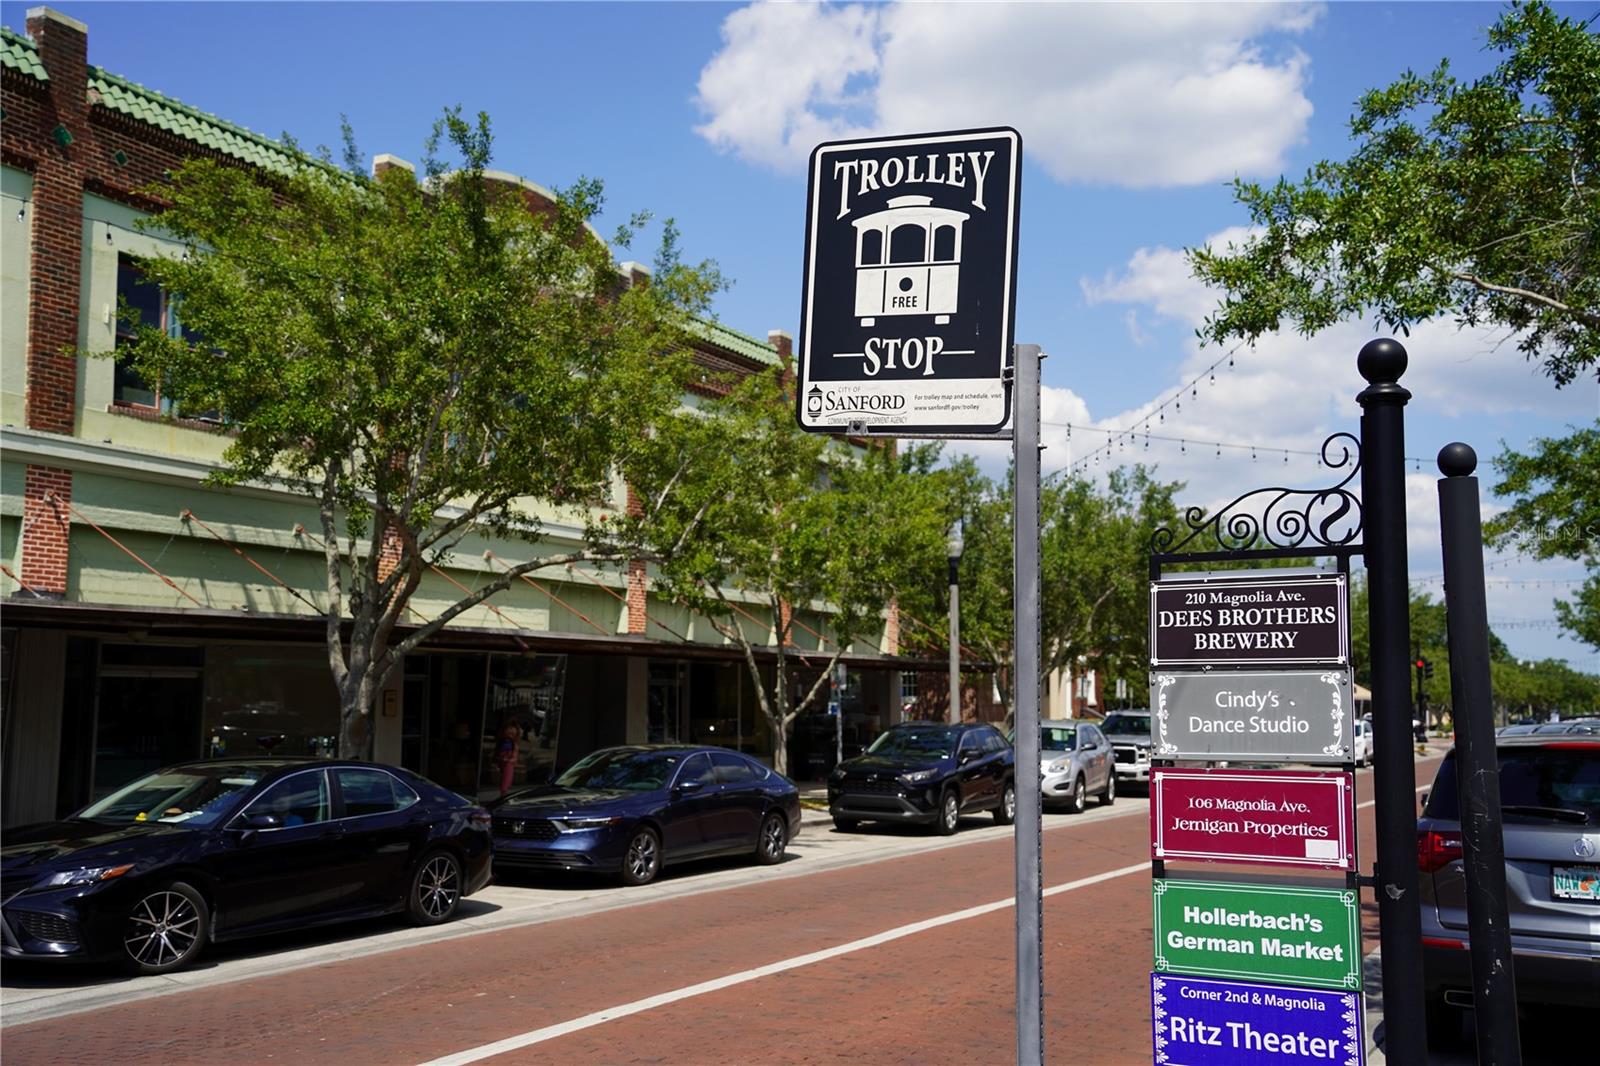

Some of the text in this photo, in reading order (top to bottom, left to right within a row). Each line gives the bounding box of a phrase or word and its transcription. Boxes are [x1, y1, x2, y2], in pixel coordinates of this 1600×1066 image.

[834, 151, 995, 220] TROLLEY
[892, 296, 918, 308] FREE
[863, 336, 944, 376] STOP
[825, 391, 905, 411] SANFORD
[1185, 589, 1306, 607] 210 Magnolia Ave.
[1159, 606, 1336, 628] DEES BROTHERS
[1194, 631, 1299, 650] BREWERY
[1215, 690, 1280, 712] Cindy's
[1189, 716, 1310, 733] Dance Studio
[1188, 797, 1311, 813] 106 Magnolia Ave.
[1172, 817, 1329, 838] Jernigan Properties
[1183, 906, 1323, 932] Hollerbach's
[1167, 931, 1344, 962] German Market
[1180, 986, 1326, 1011] Corner 2nd & Magnolia
[1170, 1016, 1340, 1059] Ritz Theater
